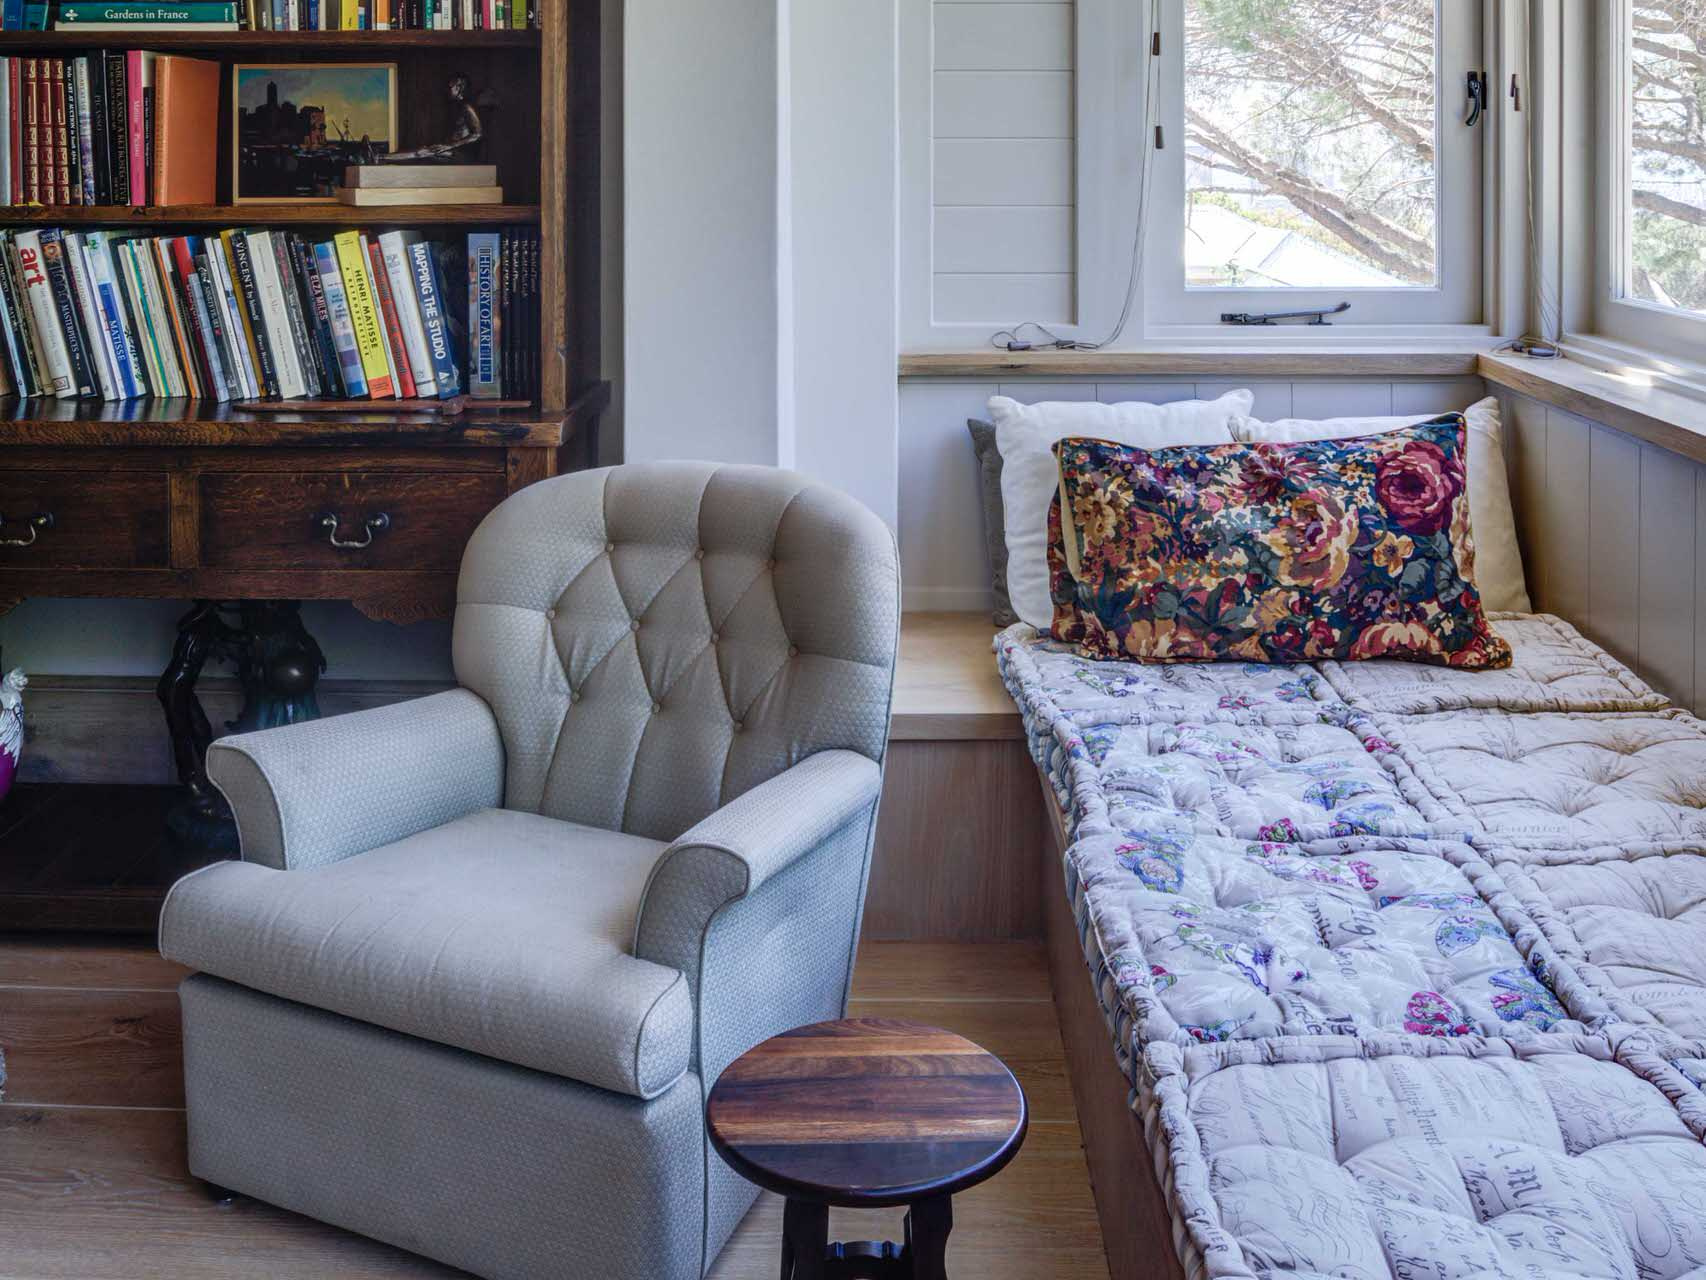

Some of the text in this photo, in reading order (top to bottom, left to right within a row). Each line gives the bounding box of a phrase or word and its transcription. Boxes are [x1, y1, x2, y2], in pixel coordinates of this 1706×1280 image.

[104, 9, 189, 20] Gardens in France
[94, 95, 103, 132] PICASSO
[20, 247, 46, 289] art
[235, 241, 254, 289] VINCENT
[310, 274, 329, 321] ELZA MILES
[347, 278, 369, 357] RETROSPECTIVE
[354, 269, 379, 350] HENRI MATISSE
[413, 243, 447, 360] MAPPING THE STUDIO
[480, 255, 491, 348] HISTORY OF ART
[61, 303, 80, 352] MASTERPIECES
[108, 319, 126, 362] MATISSE
